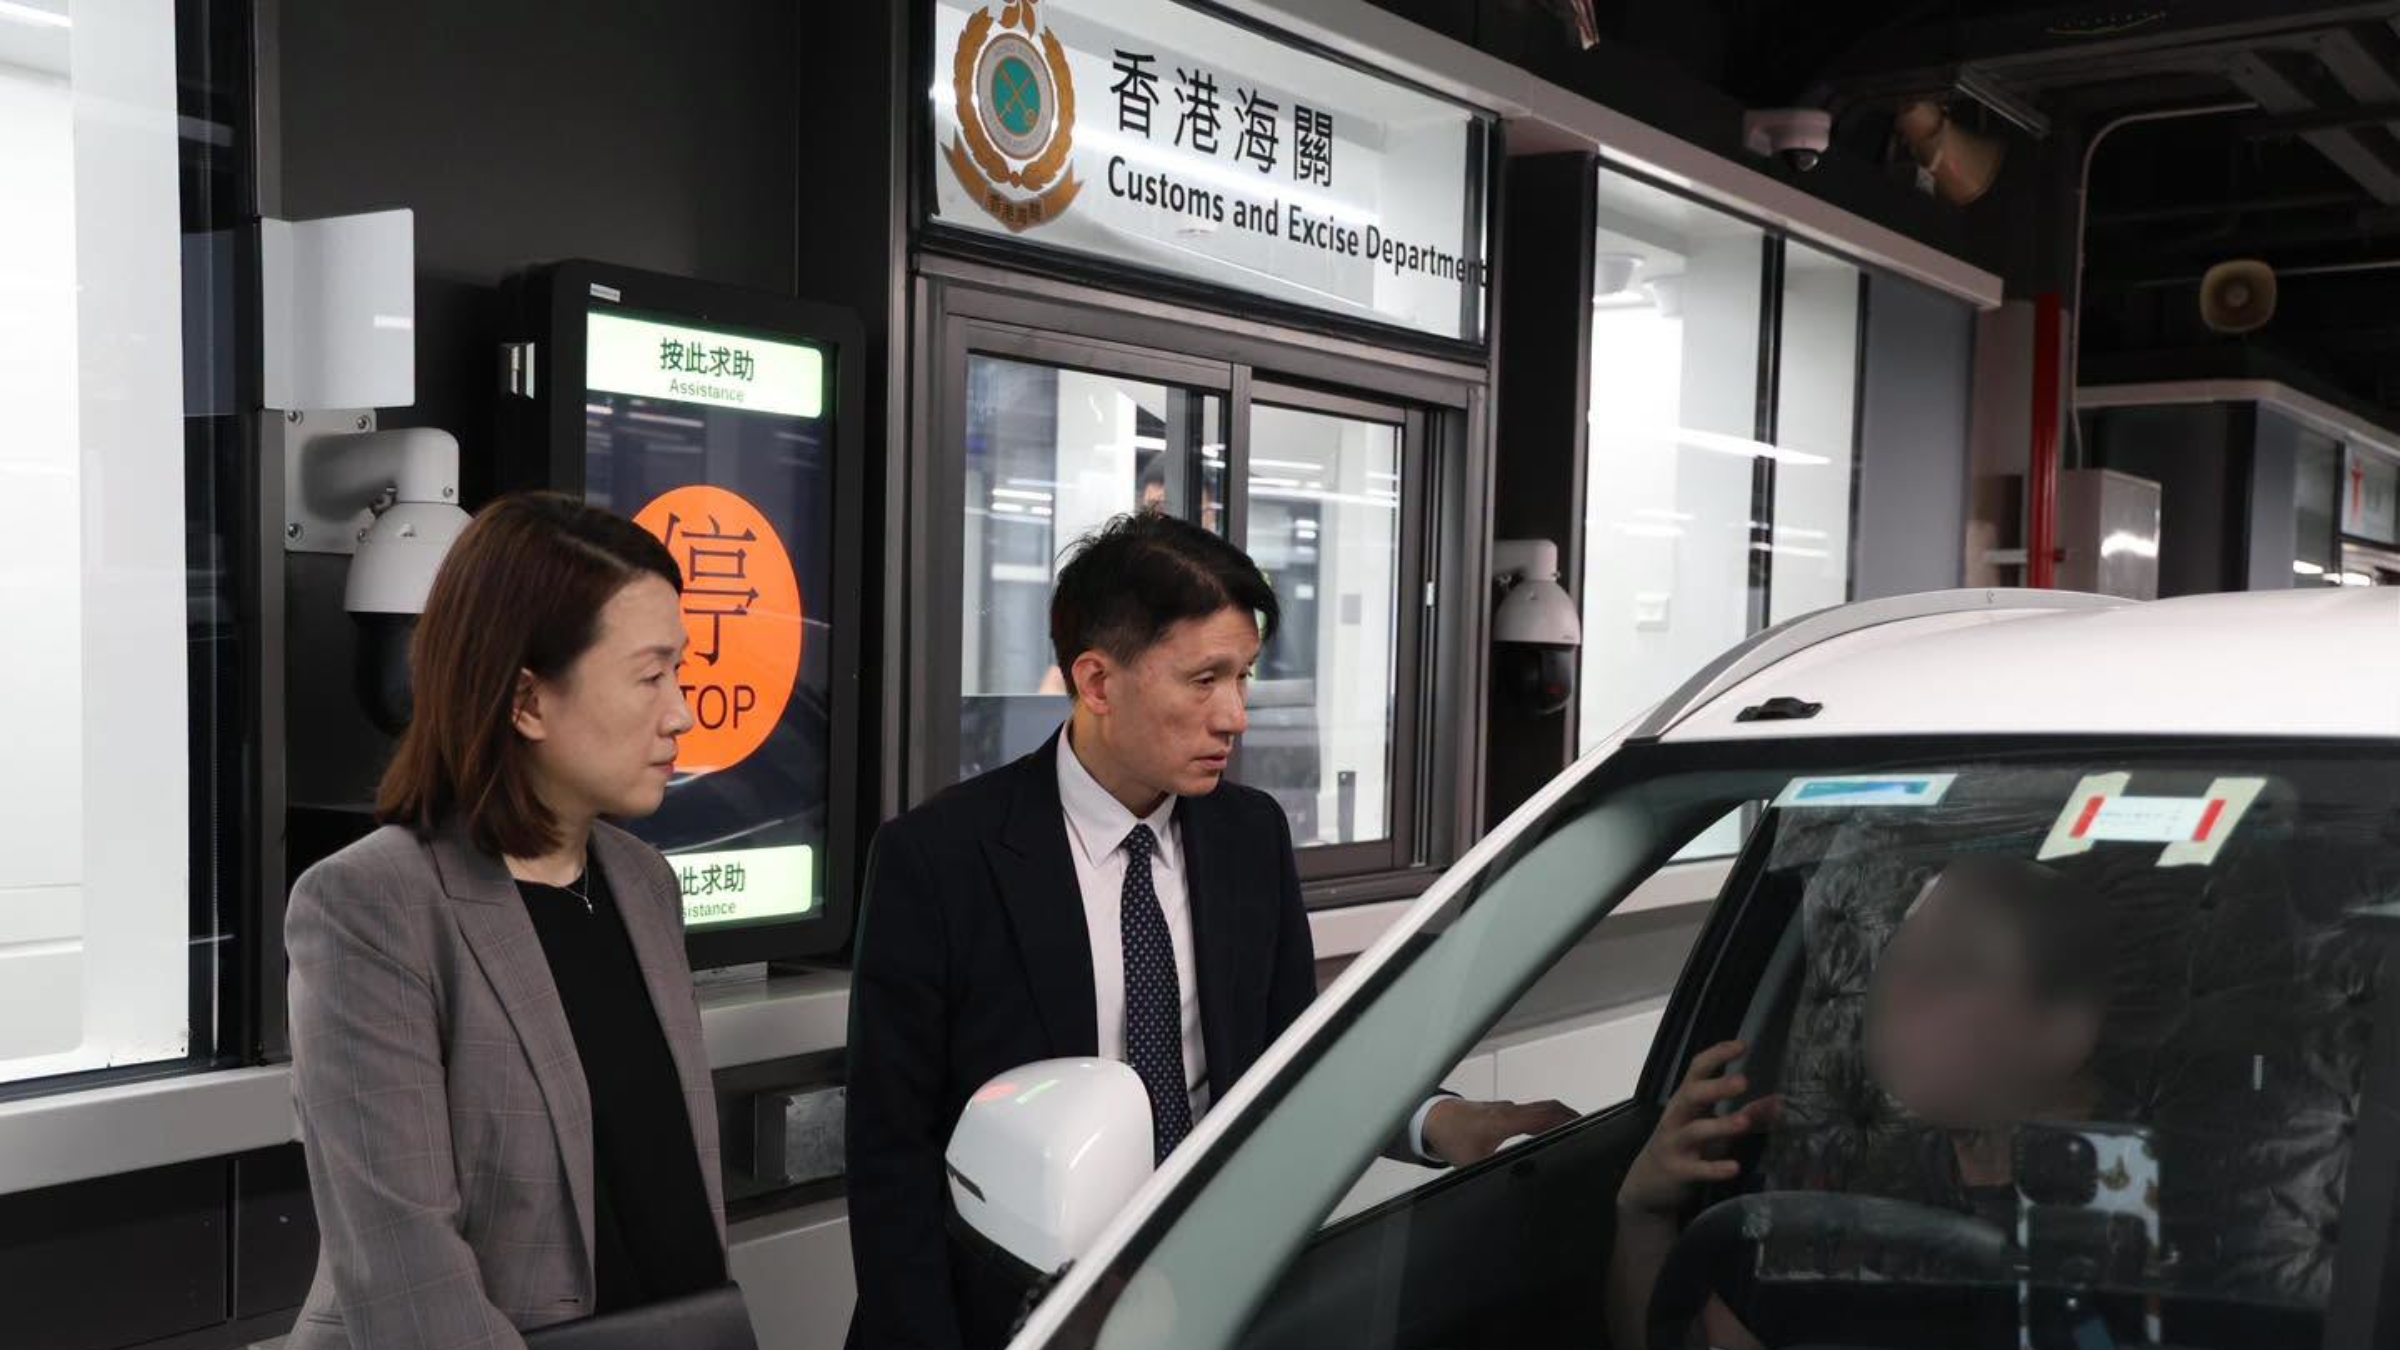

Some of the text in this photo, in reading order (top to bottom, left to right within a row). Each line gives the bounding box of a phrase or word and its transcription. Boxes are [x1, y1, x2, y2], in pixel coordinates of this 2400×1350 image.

[1110, 49, 1333, 187] 香港海關
[1108, 155, 1490, 288] Customs and Excise Department
[660, 337, 754, 381] 按此求助
[669, 378, 745, 401] Assistance
[664, 512, 759, 667] 停
[679, 684, 756, 730] OP
[678, 861, 745, 895] 此求助
[683, 902, 736, 917] sistance
